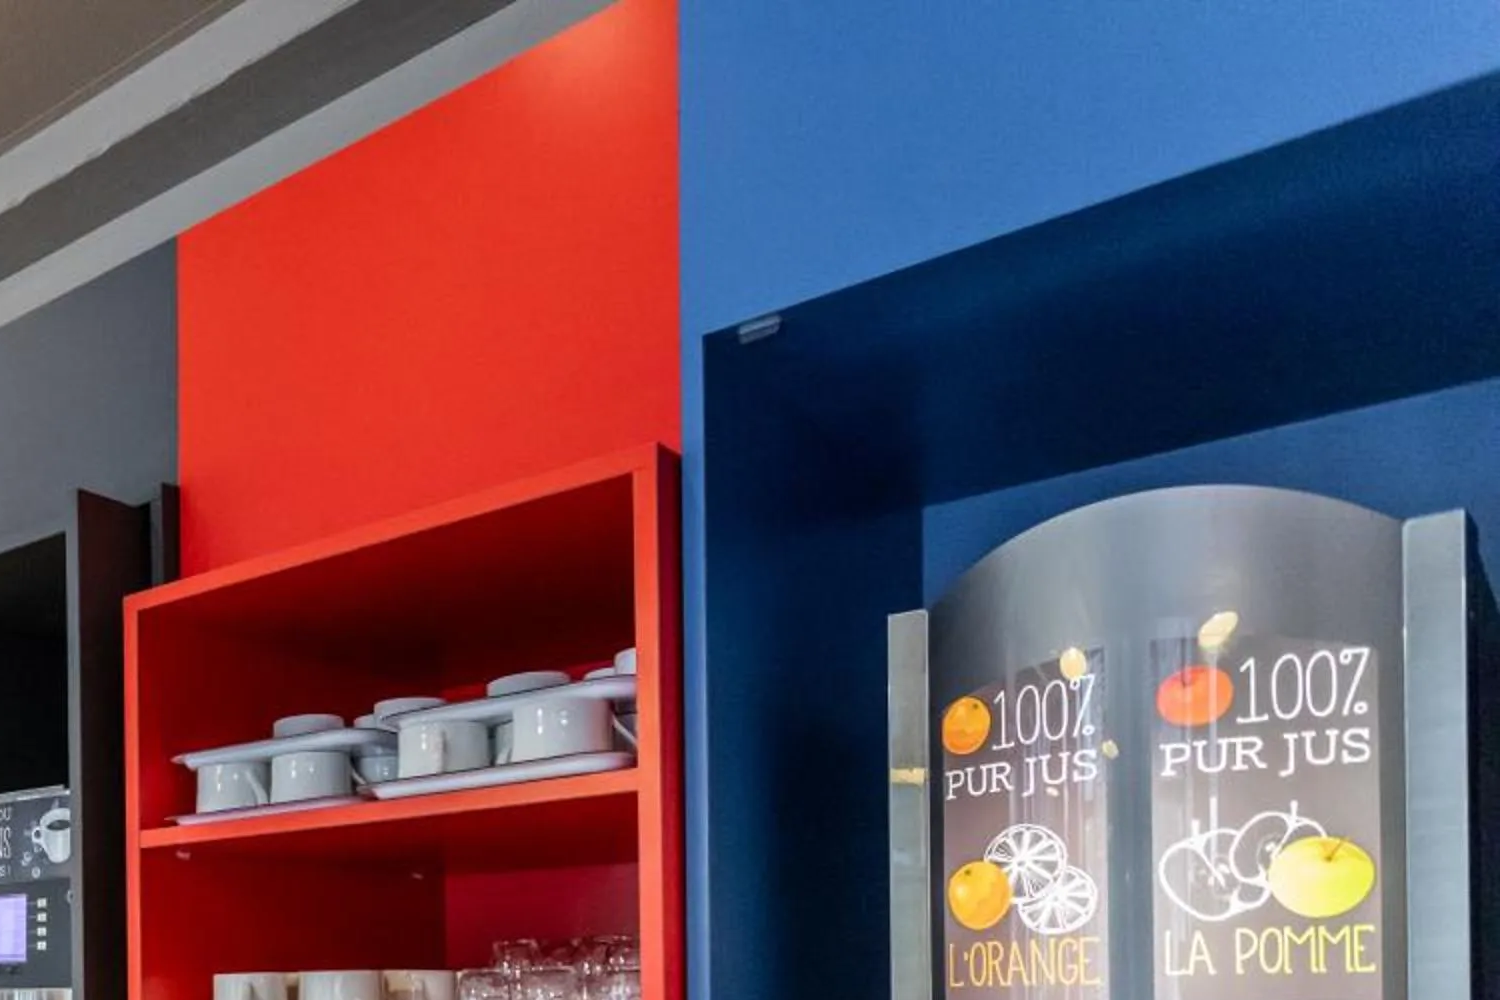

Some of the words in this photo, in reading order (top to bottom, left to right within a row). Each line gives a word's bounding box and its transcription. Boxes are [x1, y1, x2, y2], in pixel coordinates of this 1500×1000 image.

[1236, 646, 1371, 724] 100%
[991, 673, 1096, 751] 100%
[944, 761, 1015, 801] PUR
[1021, 748, 1098, 797] JUS
[1158, 735, 1268, 777] PUR
[1278, 727, 1372, 777] JUS
[949, 936, 1104, 988] L'ORANGE
[1164, 929, 1217, 977] LA
[1234, 923, 1377, 975] POMME
